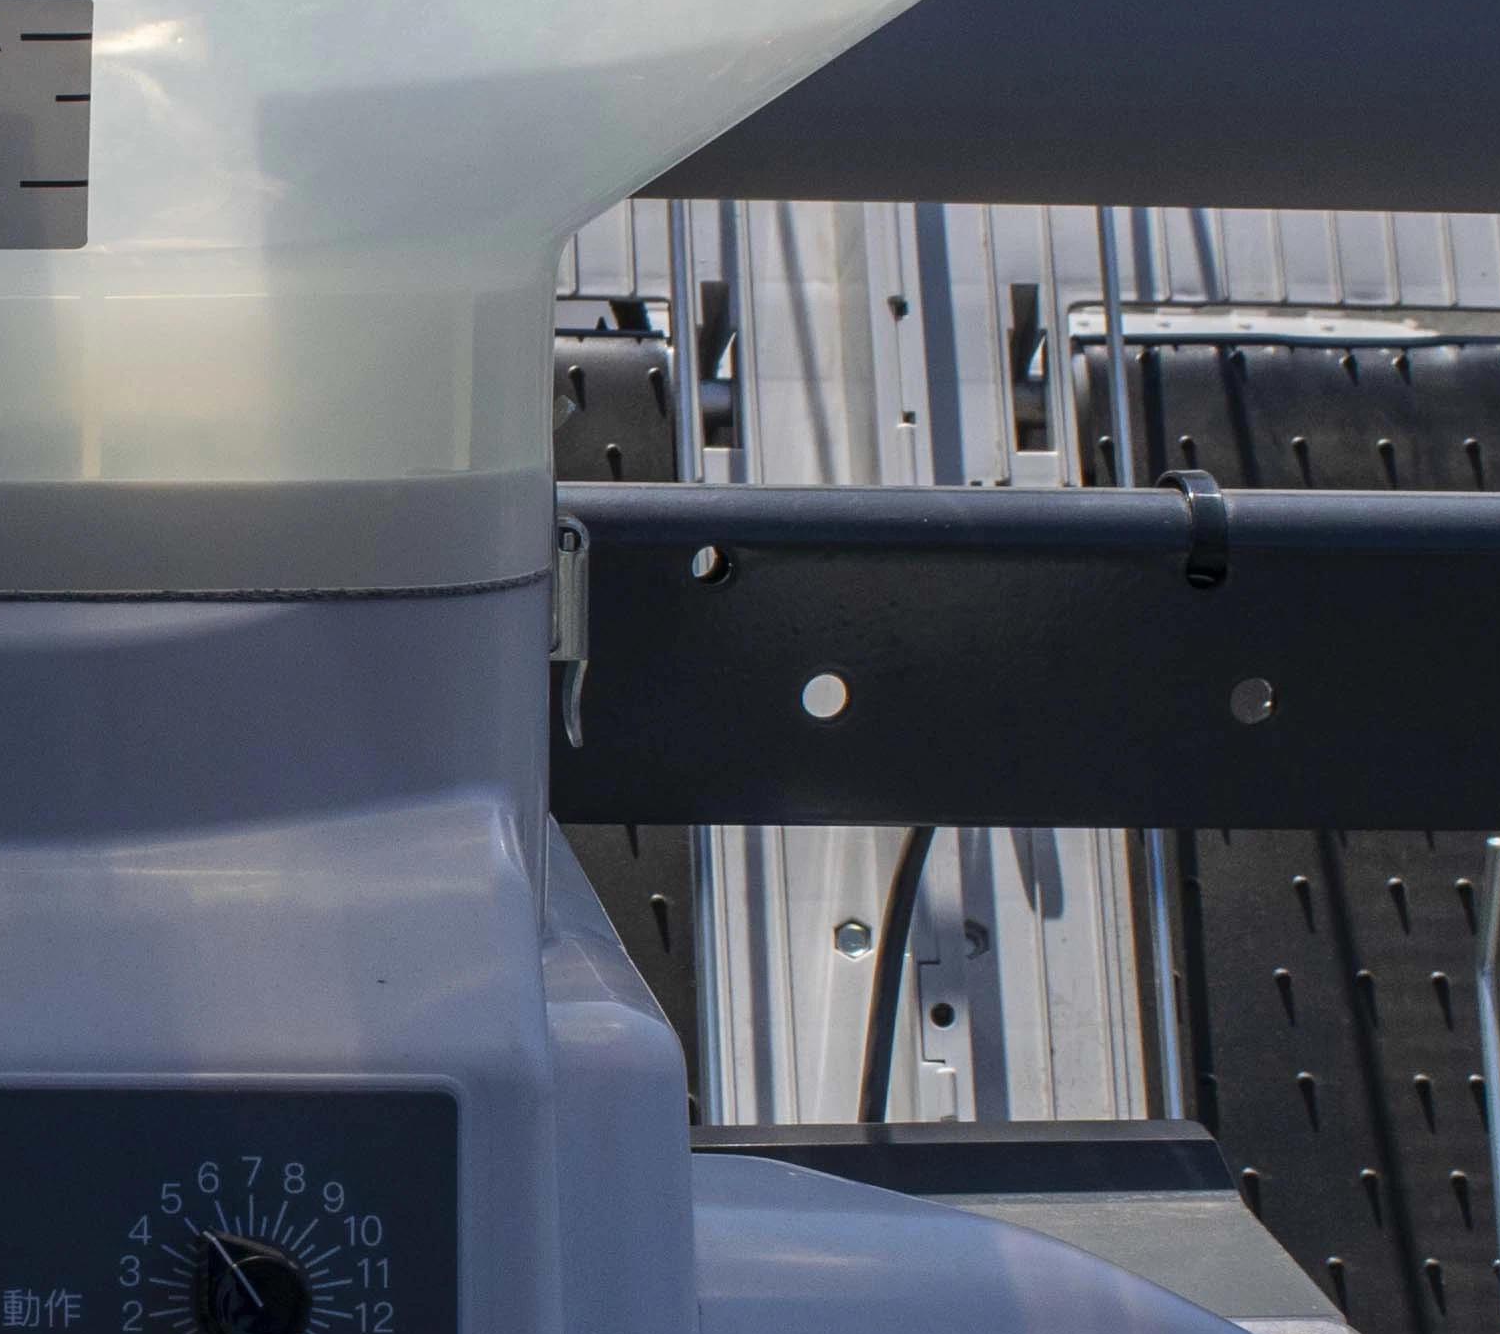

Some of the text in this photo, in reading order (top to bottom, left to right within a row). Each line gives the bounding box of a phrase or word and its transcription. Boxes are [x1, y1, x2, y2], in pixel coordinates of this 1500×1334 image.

[197, 1161, 219, 1193] 6
[242, 1156, 262, 1187] 7
[283, 1162, 306, 1194] 8
[161, 1182, 183, 1214] 5
[323, 1181, 345, 1213] 9
[128, 1215, 152, 1245] 4
[344, 1215, 383, 1247] 10
[119, 1255, 140, 1287] 3
[357, 1258, 388, 1289] 11
[3, 1288, 83, 1327] 動作
[122, 1300, 144, 1332] 2
[355, 1301, 394, 1333] 12
